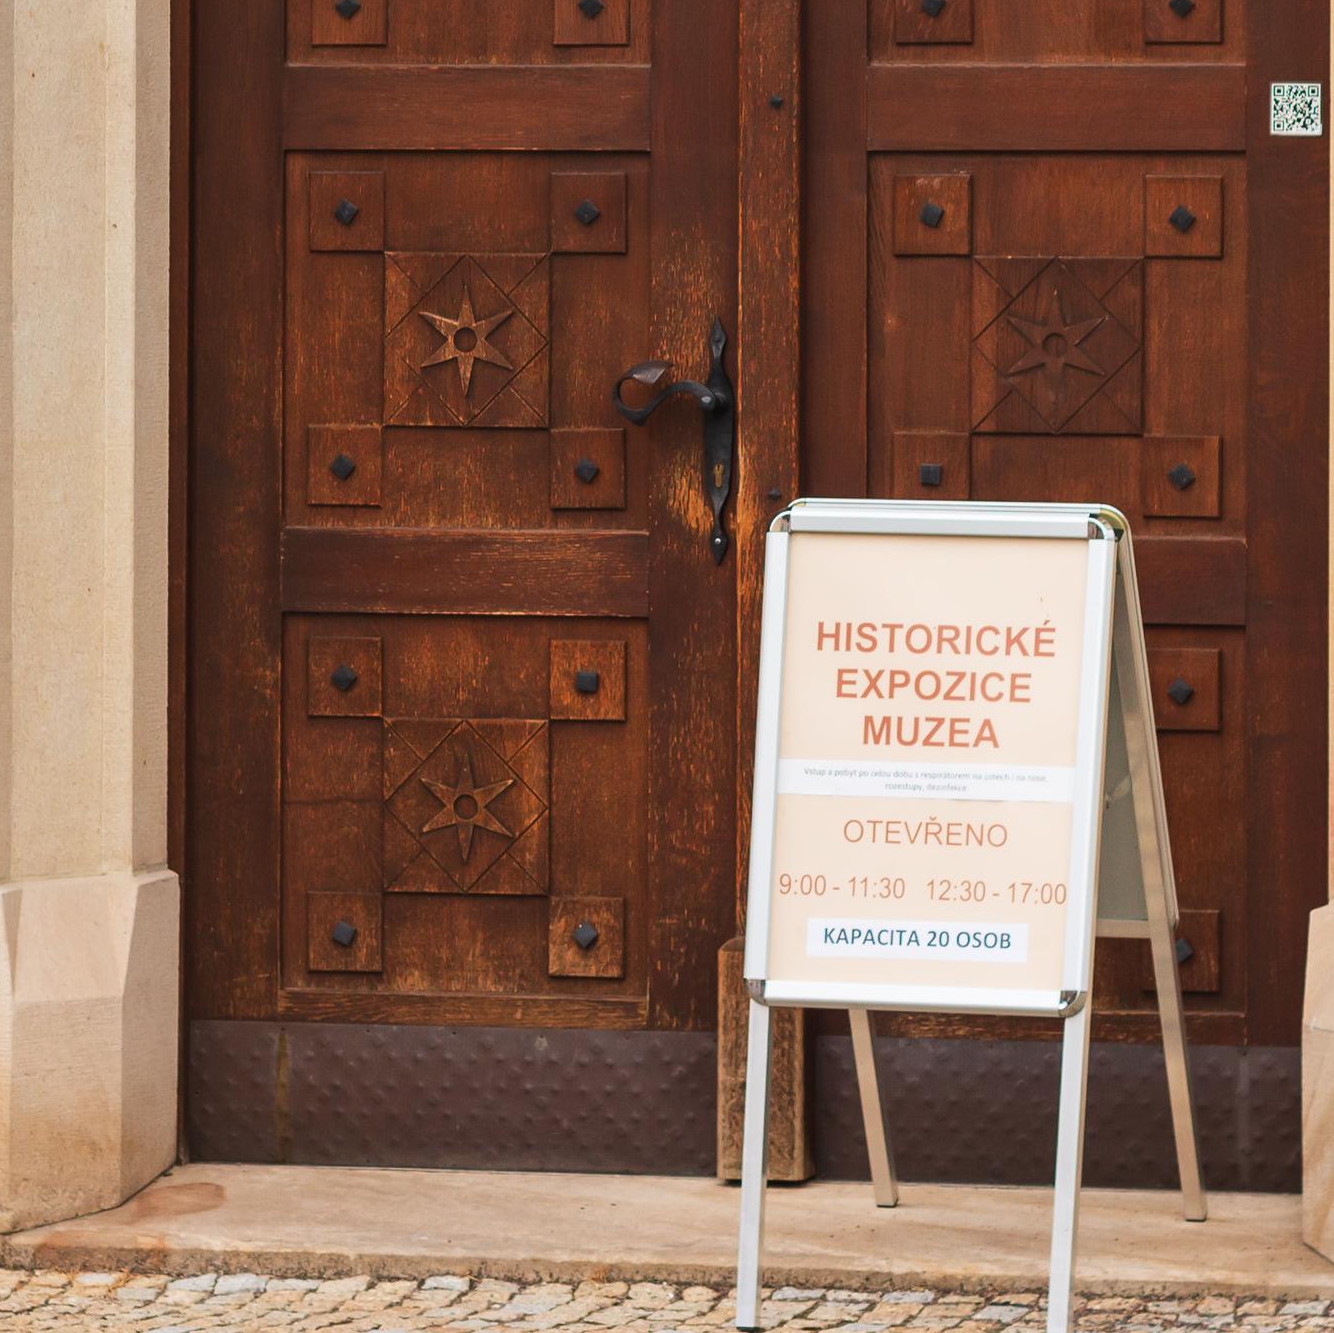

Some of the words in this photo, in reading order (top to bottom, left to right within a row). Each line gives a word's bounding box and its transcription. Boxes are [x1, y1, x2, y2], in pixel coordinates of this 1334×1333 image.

[816, 619, 1057, 658] HISTORICKÉ
[835, 668, 1032, 703] EXPOZICE
[862, 715, 1000, 748] MUZEA
[834, 768, 857, 778] pobyt
[858, 770, 869, 778] po
[843, 816, 1008, 847] OTEVŘENO
[778, 873, 827, 896] 9:00
[848, 876, 906, 899] 11:30
[926, 879, 986, 902] 12:30
[1008, 882, 1067, 905] 17:00
[823, 927, 920, 947] KAPACITA
[927, 930, 949, 948] 20
[956, 931, 1012, 949] OSOB
